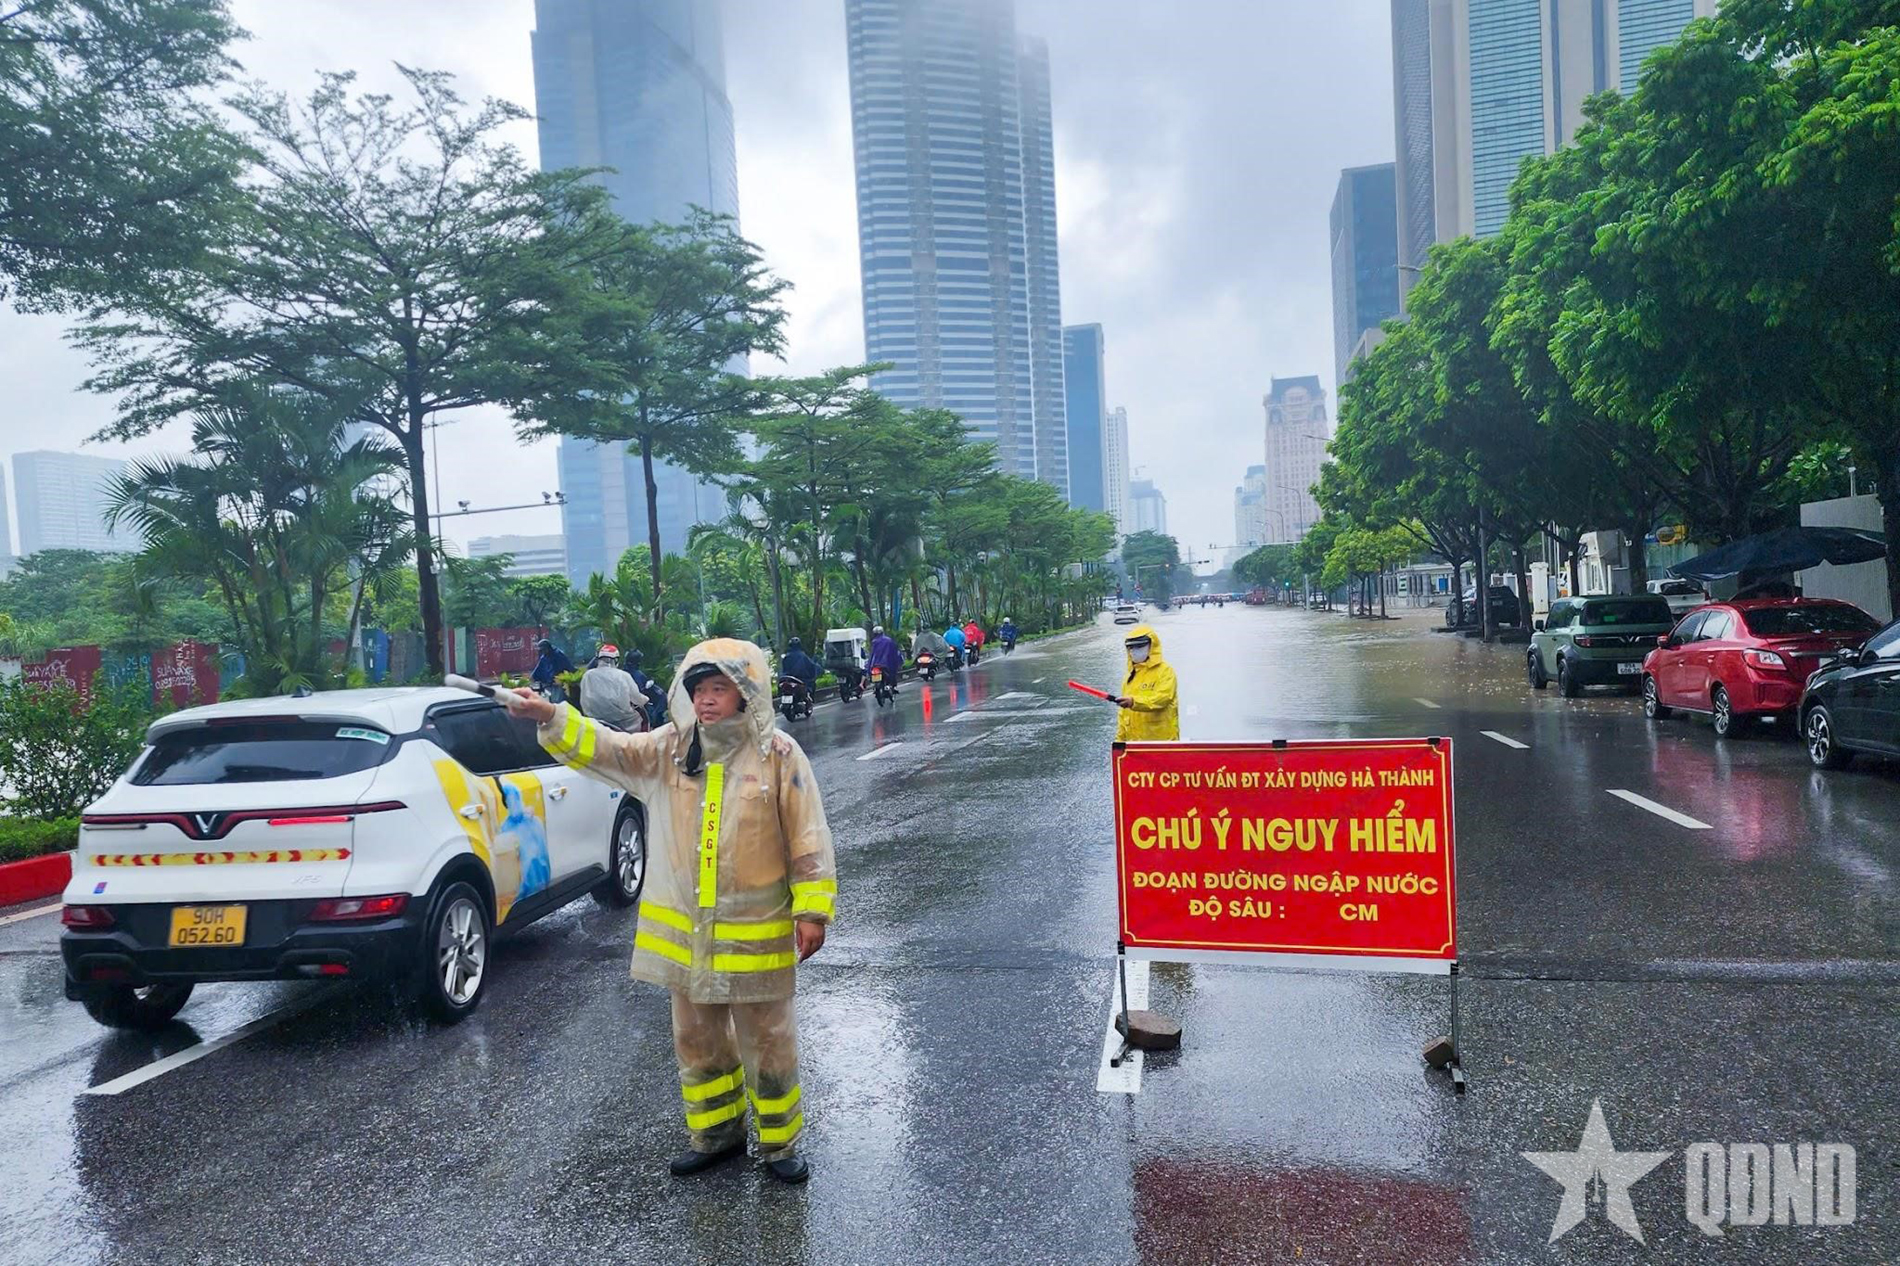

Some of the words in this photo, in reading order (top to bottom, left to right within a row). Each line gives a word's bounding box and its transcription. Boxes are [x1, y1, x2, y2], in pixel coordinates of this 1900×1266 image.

[1127, 772, 1155, 788] CTY
[1160, 772, 1180, 788] CP
[1183, 771, 1202, 788] TƯ
[1205, 765, 1237, 788] VẤN
[1241, 772, 1261, 788] ĐT
[1264, 767, 1296, 788] XÂY
[1301, 770, 1348, 793] DỰNG
[1352, 766, 1375, 788] HÀ
[1379, 765, 1434, 788] THÀNH
[706, 802, 716, 869] CSGT
[1131, 807, 1202, 850] CHÚ
[1211, 807, 1232, 850] Ý
[1242, 817, 1339, 852] NGUY
[1350, 798, 1437, 853] HIỂM
[1133, 872, 1197, 894] ĐOẠN
[1204, 868, 1287, 892] ĐƯỜNG
[1294, 870, 1360, 897] NGẬP
[1367, 872, 1438, 895] NƯỚC
[193, 907, 224, 925] 90H
[1189, 895, 1223, 922] ĐỘ
[1229, 896, 1272, 919] SÂU
[1339, 903, 1378, 922] CM
[177, 926, 236, 944] 052.60
